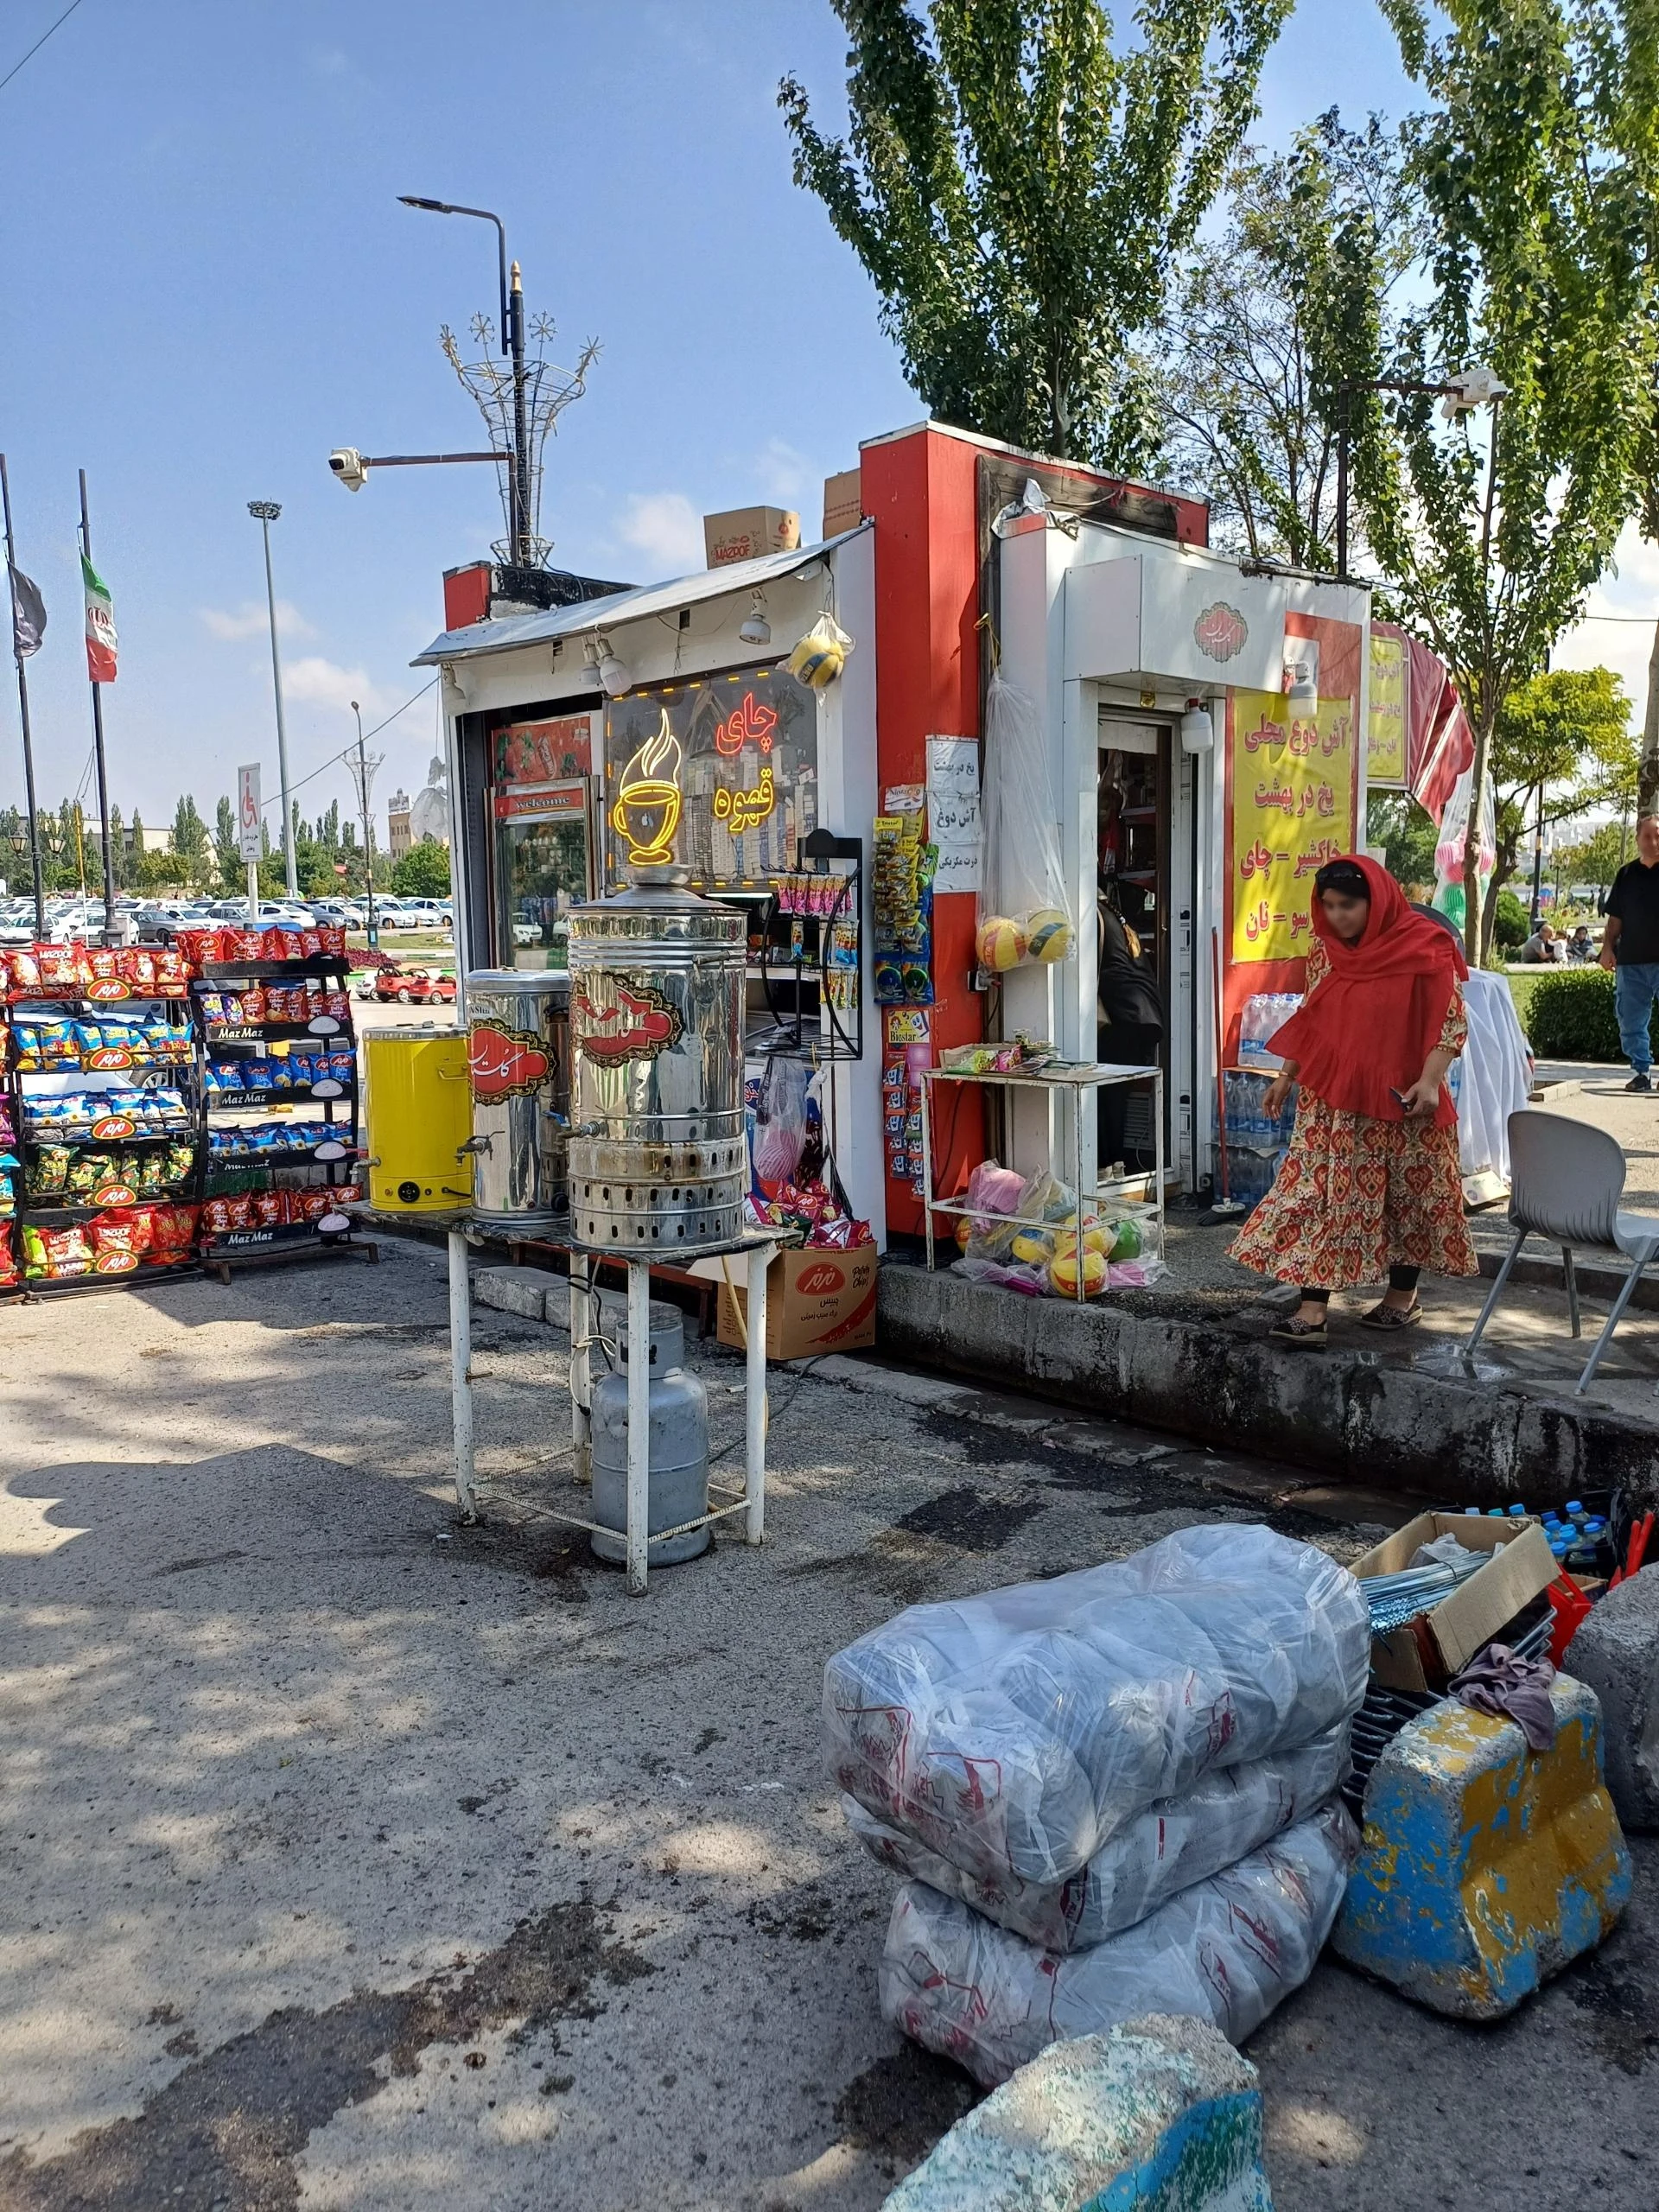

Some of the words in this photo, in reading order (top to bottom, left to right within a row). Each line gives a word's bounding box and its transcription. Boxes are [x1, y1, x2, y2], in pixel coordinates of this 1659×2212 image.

[716, 691, 777, 754] چای
[1244, 712, 1286, 752] محلی
[1288, 719, 1318, 755] دوغ
[1322, 715, 1348, 756] آش
[516, 797, 570, 809] welcome
[715, 768, 773, 830] قهوه
[1255, 778, 1294, 815] بهشت
[1297, 785, 1314, 817] در
[1318, 781, 1334, 816] یخ
[937, 807, 956, 828] دوغ
[959, 807, 976, 828] آش
[1240, 839, 1272, 880] چای
[1246, 900, 1268, 941] نان
[804, 1268, 836, 1292] مزمز
